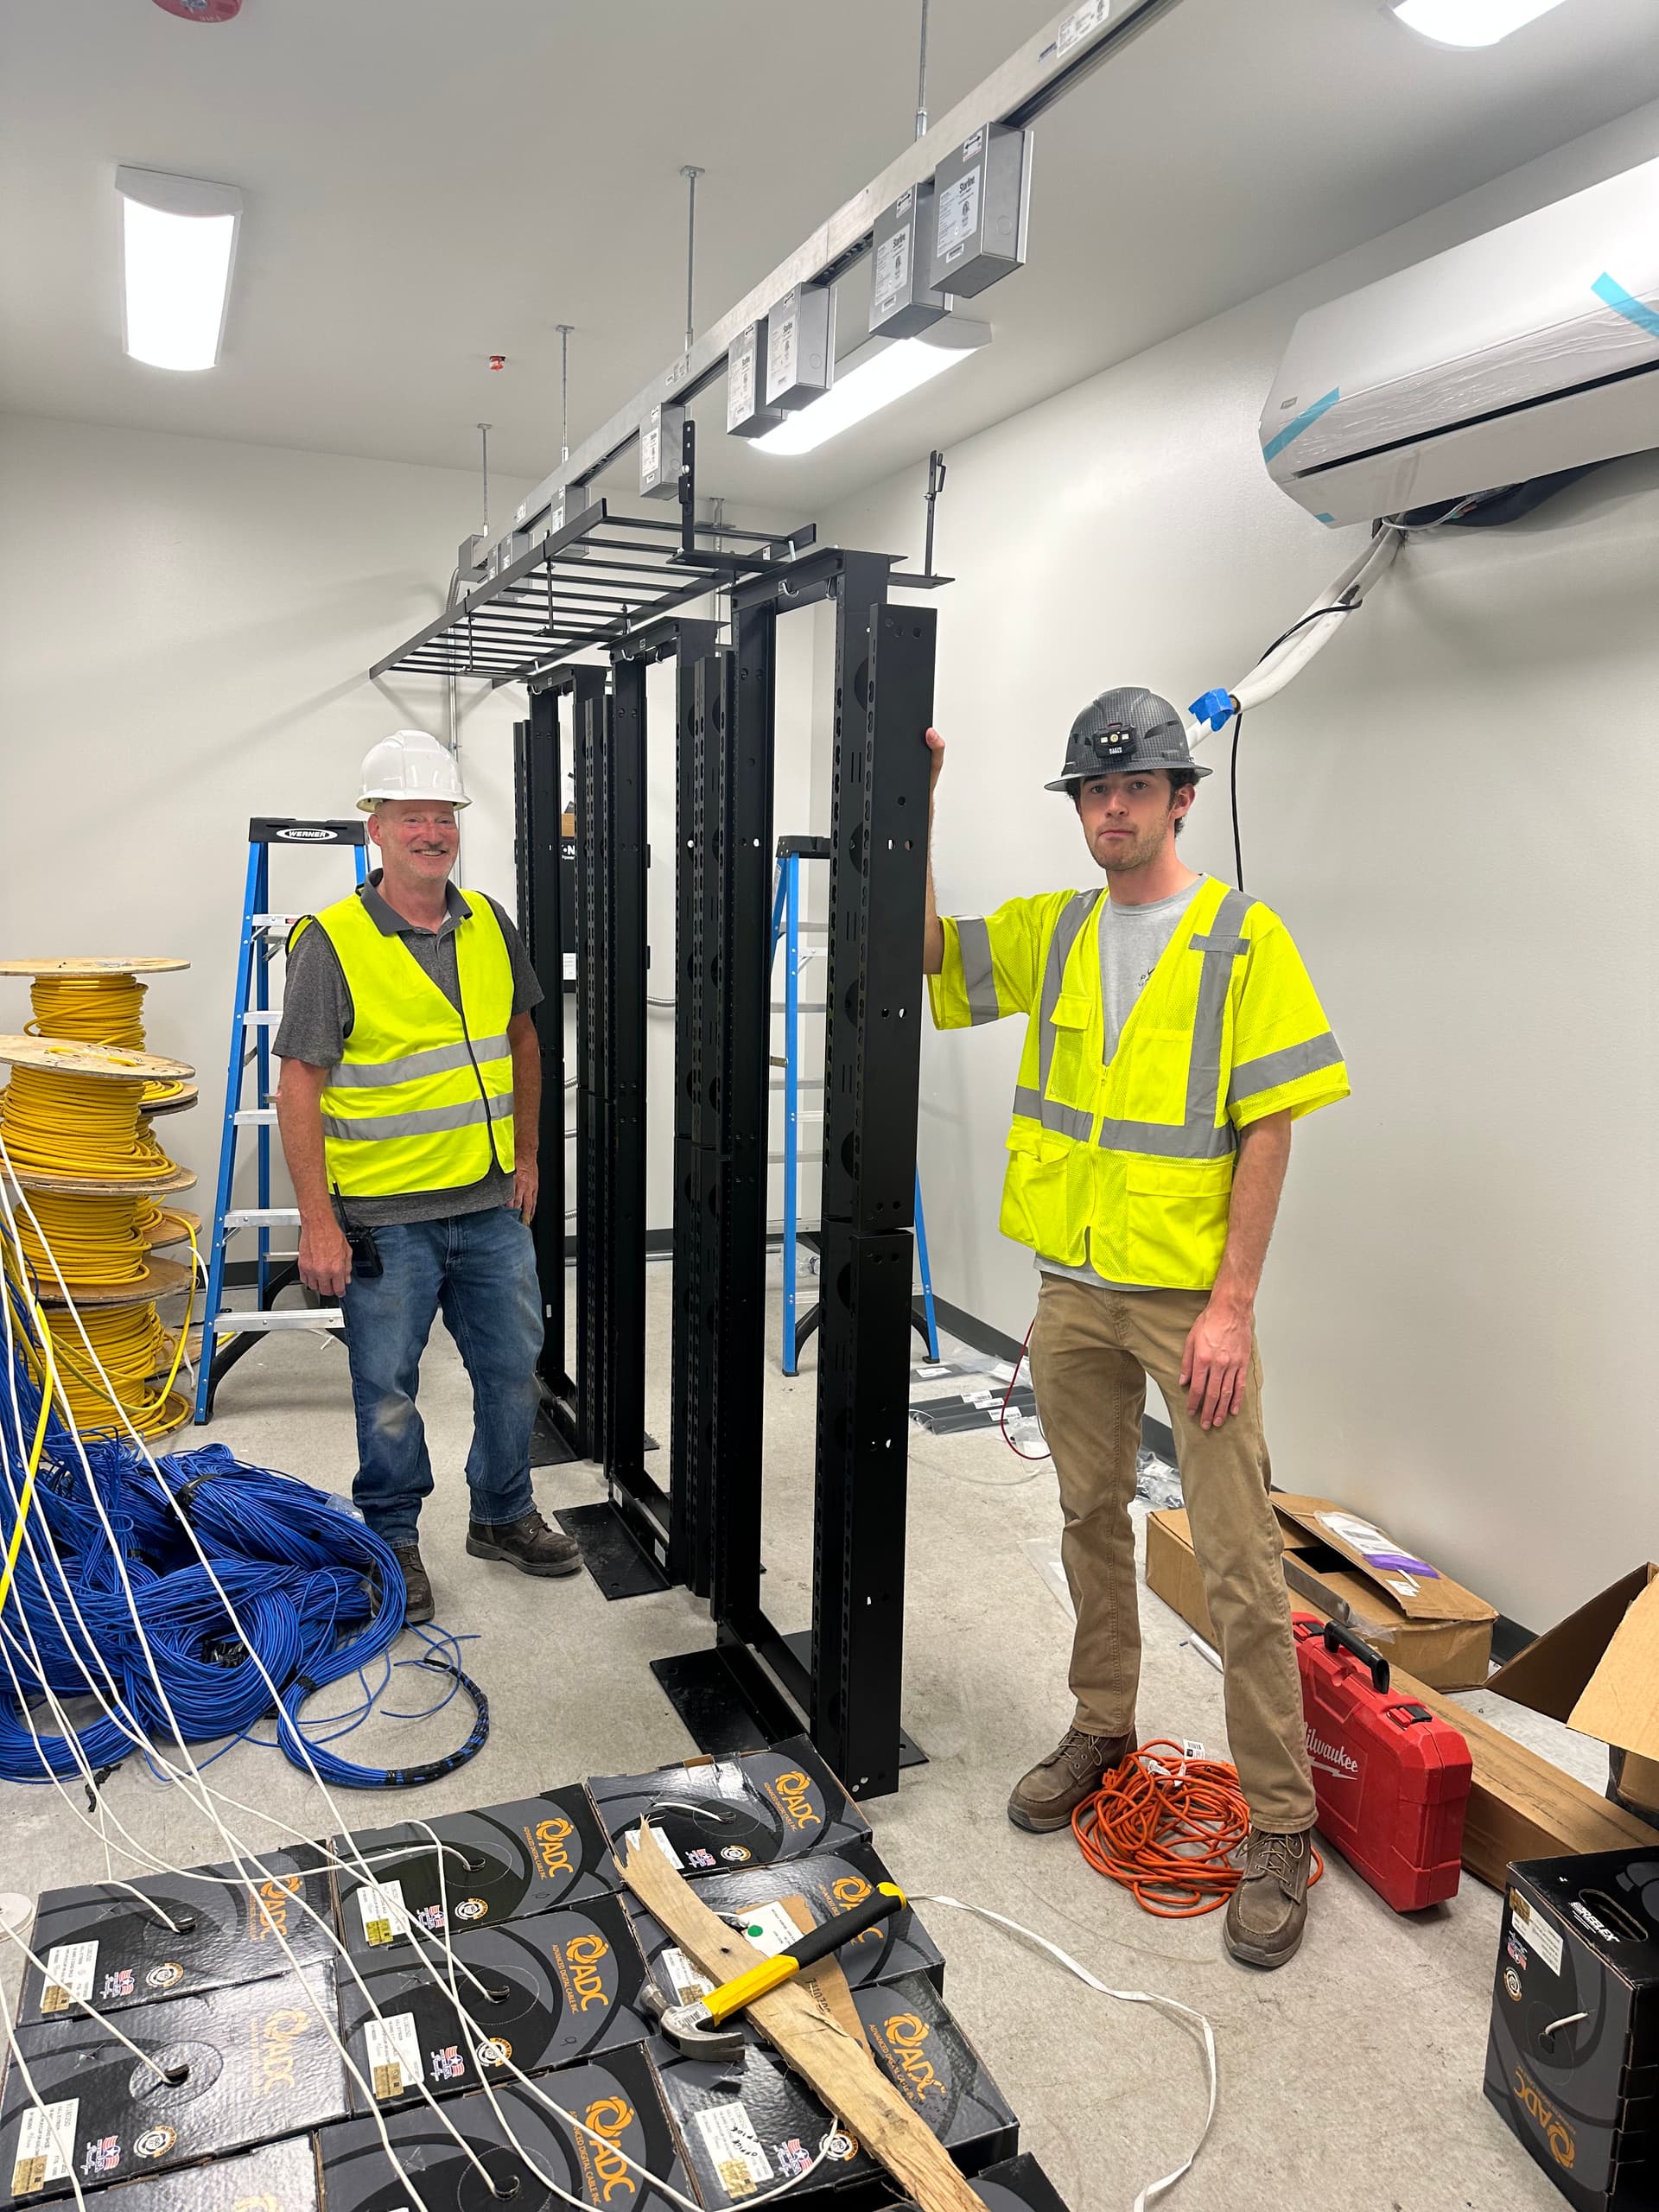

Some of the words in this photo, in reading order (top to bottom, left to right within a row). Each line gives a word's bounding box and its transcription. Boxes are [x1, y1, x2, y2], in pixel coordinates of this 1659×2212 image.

[1305, 1722, 1358, 1772] ilwaukee
[781, 1796, 822, 1830] ADC
[538, 1843, 574, 1878] ADC
[552, 1945, 565, 1969] ADVANCED
[559, 1969, 571, 1988] DIGITAL
[569, 1966, 609, 2012] ADC
[893, 2050, 948, 2101] ADC
[1513, 2069, 1552, 2127] ADC
[578, 2145, 592, 2171] DIGITAL
[585, 2171, 598, 2192] CABLE
[588, 2139, 636, 2202] ADC
